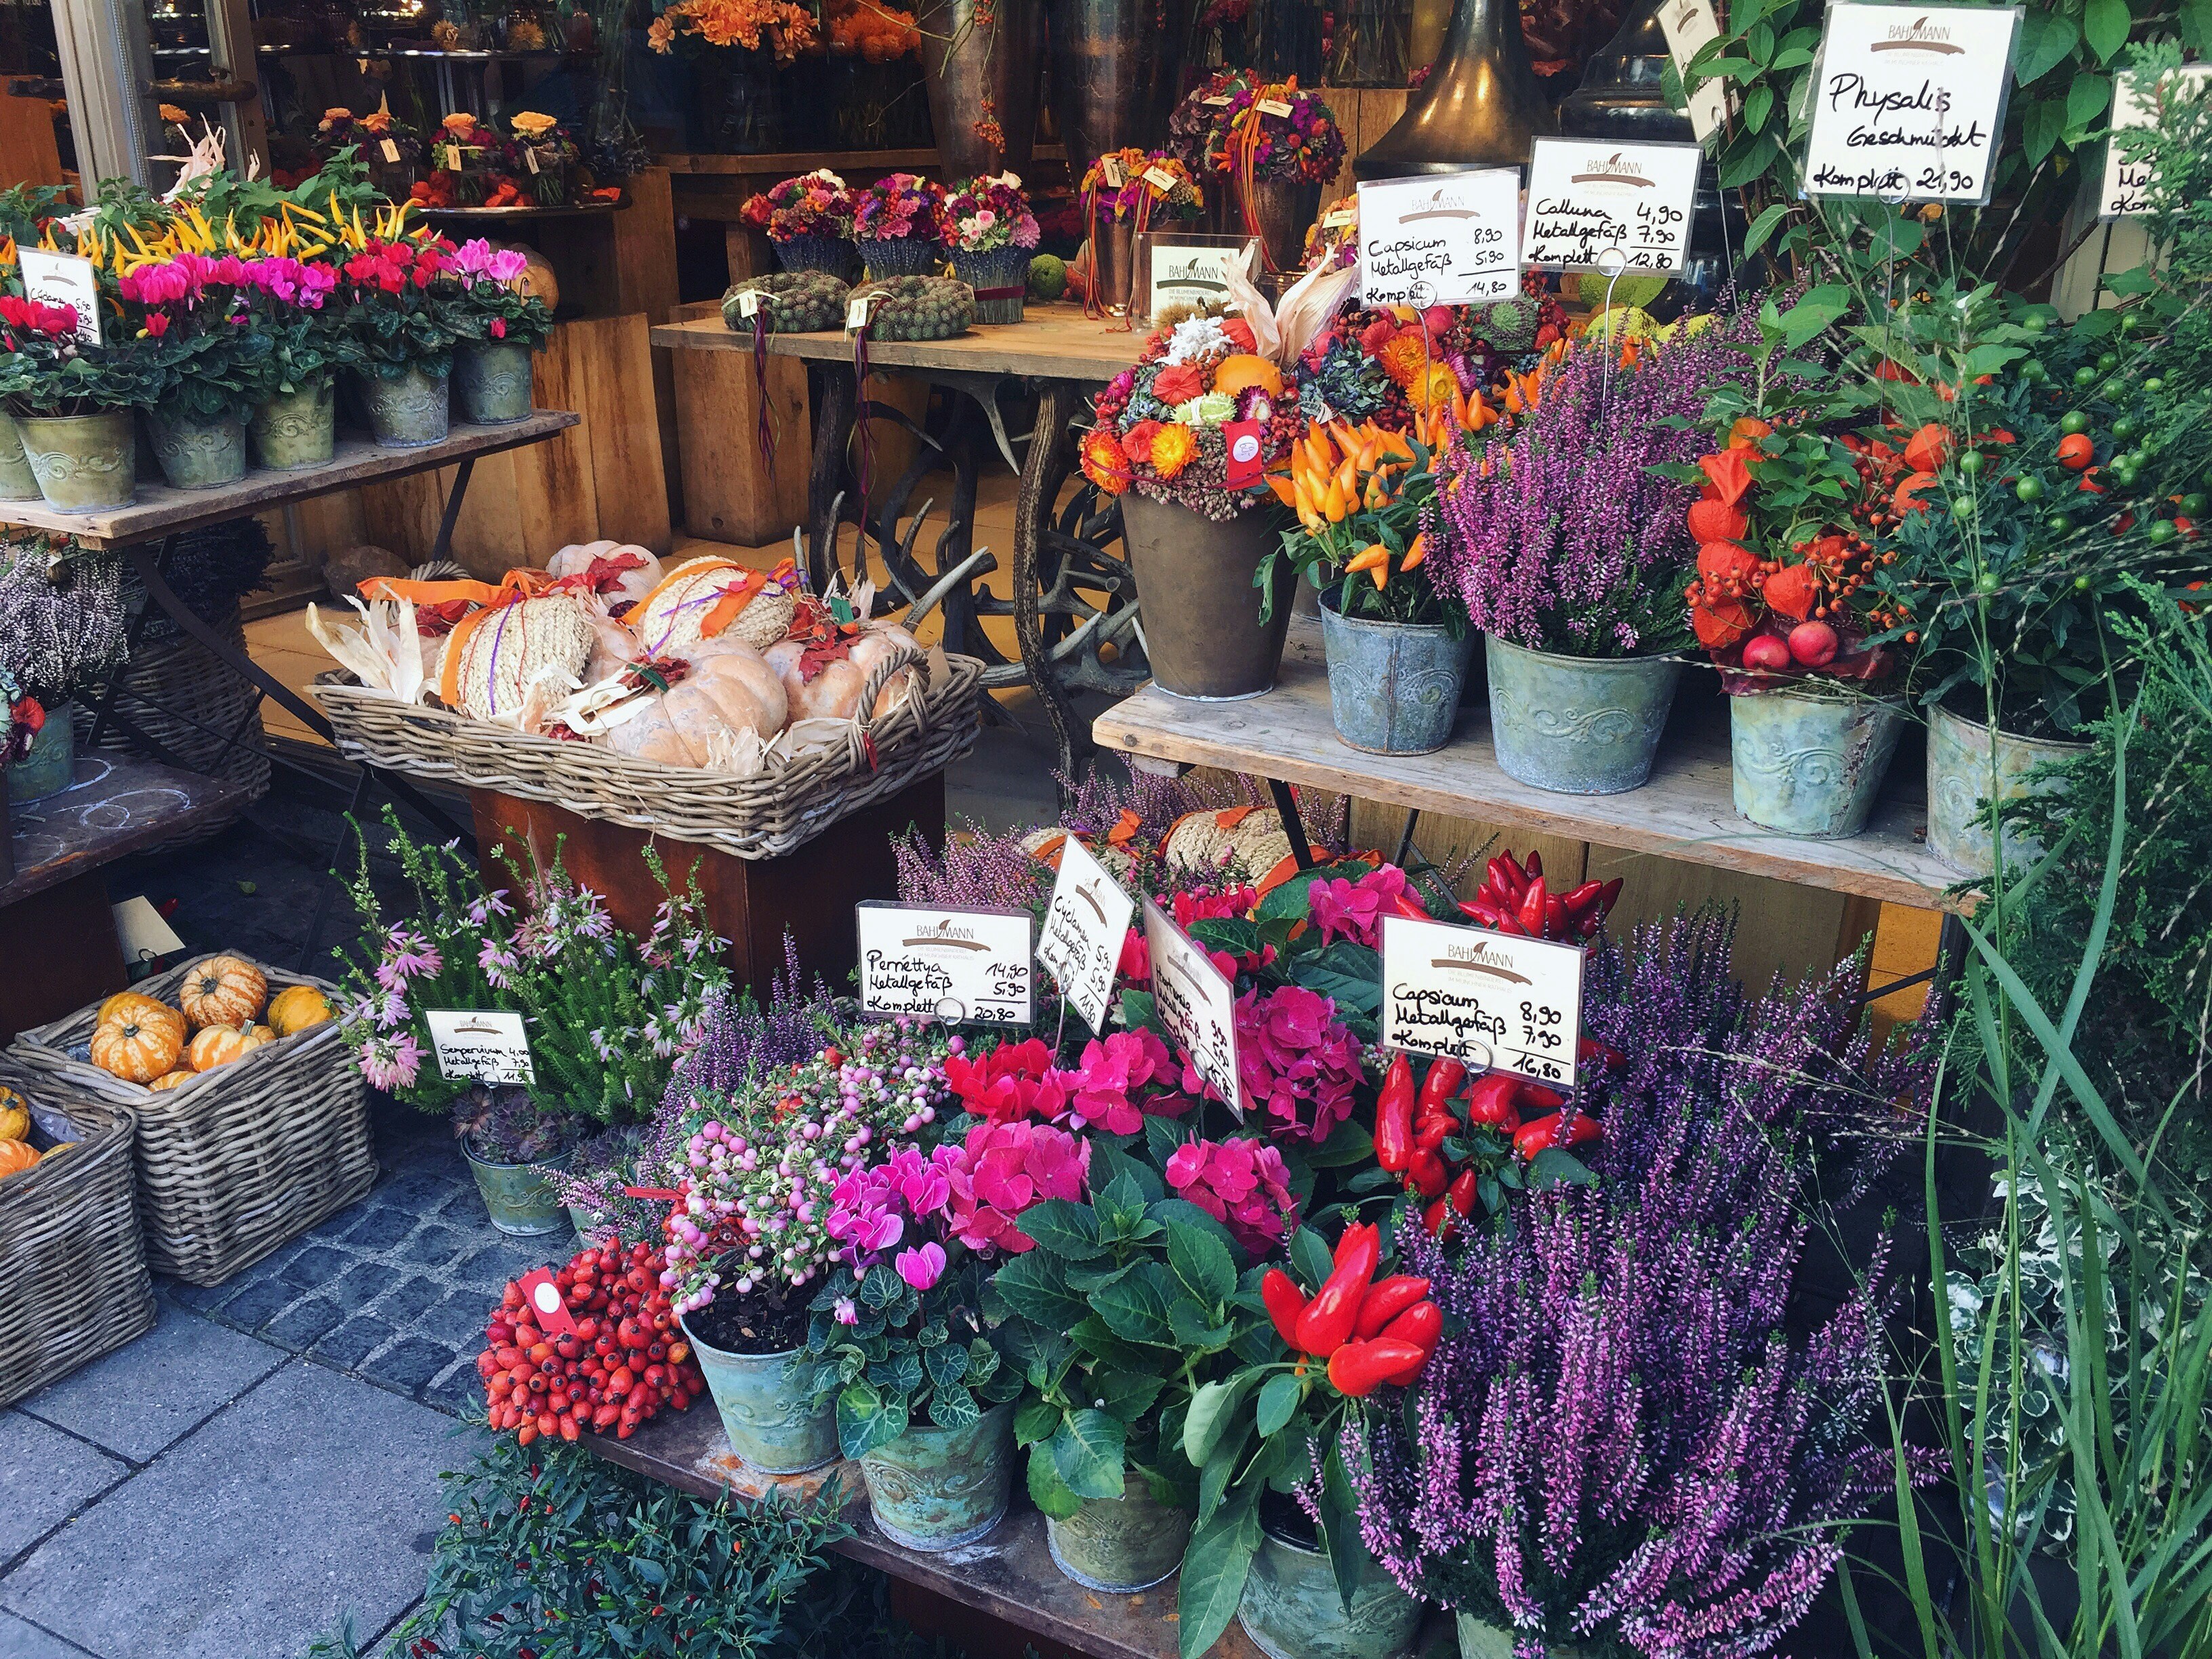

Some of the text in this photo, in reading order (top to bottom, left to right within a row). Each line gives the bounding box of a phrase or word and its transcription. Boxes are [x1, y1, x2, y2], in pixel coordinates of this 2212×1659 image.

[1536, 198, 1683, 226] Calluna 4,90
[1368, 228, 1502, 260] Capsicum 8,90
[1637, 225, 1676, 243] 7,90
[1370, 250, 1504, 280] Metallgefäß 5,90
[1528, 244, 1673, 269] Komplett 12,80
[1366, 281, 1507, 308] Kompett 14,80
[916, 924, 974, 939] BAHLMANN
[1096, 944, 1111, 972] 5,90
[1448, 944, 1513, 968] BAHLMANN
[985, 962, 1029, 979] 14,90
[1090, 967, 1106, 993] 5,90
[993, 981, 1026, 997] 5,90
[867, 996, 1016, 1021] Komplett 20,80
[1393, 983, 1562, 1026] Capsicum 8,90
[1395, 1003, 1562, 1049] Metallgefäß 7,90
[1512, 1053, 1561, 1079] 16,80
